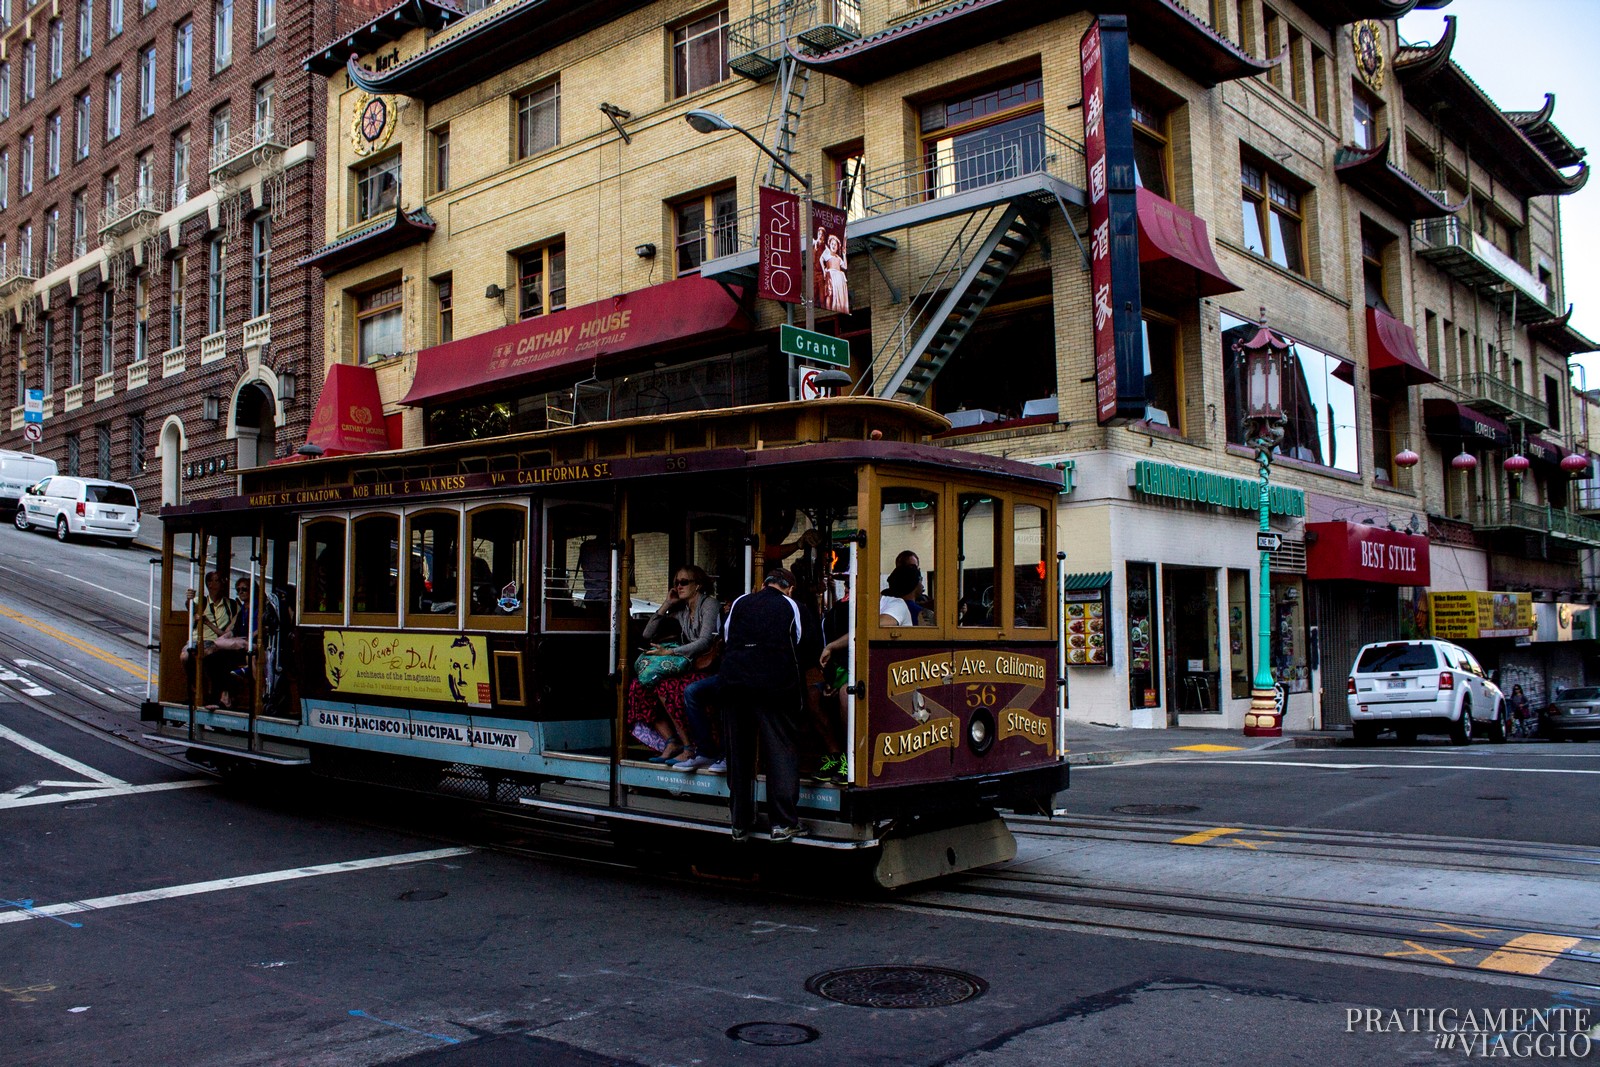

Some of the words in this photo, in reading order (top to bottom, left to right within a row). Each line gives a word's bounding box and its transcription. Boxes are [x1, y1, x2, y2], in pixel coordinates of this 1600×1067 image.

[812, 206, 845, 225] SWEENEY
[770, 200, 792, 296] OPERA
[516, 325, 574, 356] CATHAY
[578, 309, 632, 340] HOUSE
[510, 346, 569, 368] RESTAURANT
[575, 332, 627, 353] COCKTAILS
[796, 335, 836, 358] Grant
[341, 424, 364, 435] CATHAY
[365, 426, 385, 436] HOUSE
[665, 456, 687, 471] 56
[249, 494, 276, 506] MARKET
[352, 485, 369, 498] NOB
[374, 483, 395, 496] HILL
[420, 479, 438, 492] VAN
[441, 476, 466, 491] NESS
[517, 465, 590, 484] CALIFORNIA
[1142, 459, 1232, 508] CHINATOWN
[1233, 478, 1260, 511] FOO
[1269, 485, 1306, 518] COURT
[1259, 537, 1267, 547] ONE
[1267, 538, 1276, 547] WAY
[1360, 540, 1385, 569] BEST
[1388, 544, 1417, 572] STYLE
[356, 670, 385, 680] Architects
[386, 672, 392, 680] of
[392, 672, 403, 681] the
[404, 673, 441, 684] Imagination
[891, 665, 918, 688] Van
[919, 660, 957, 682] Ness
[996, 656, 1045, 680] California
[965, 684, 997, 707] 56
[319, 712, 339, 726] SAN
[342, 716, 400, 734] FRANCISCO
[402, 722, 463, 741] MUNICIPAL
[467, 729, 518, 748] RAILWAY
[1007, 712, 1047, 737] Streets
[883, 735, 895, 756] &
[899, 721, 954, 754] Market
[657, 775, 669, 783] TWO
[669, 776, 695, 786] STANDEES
[696, 780, 711, 788] ONLY
[816, 795, 833, 803] ONLY
